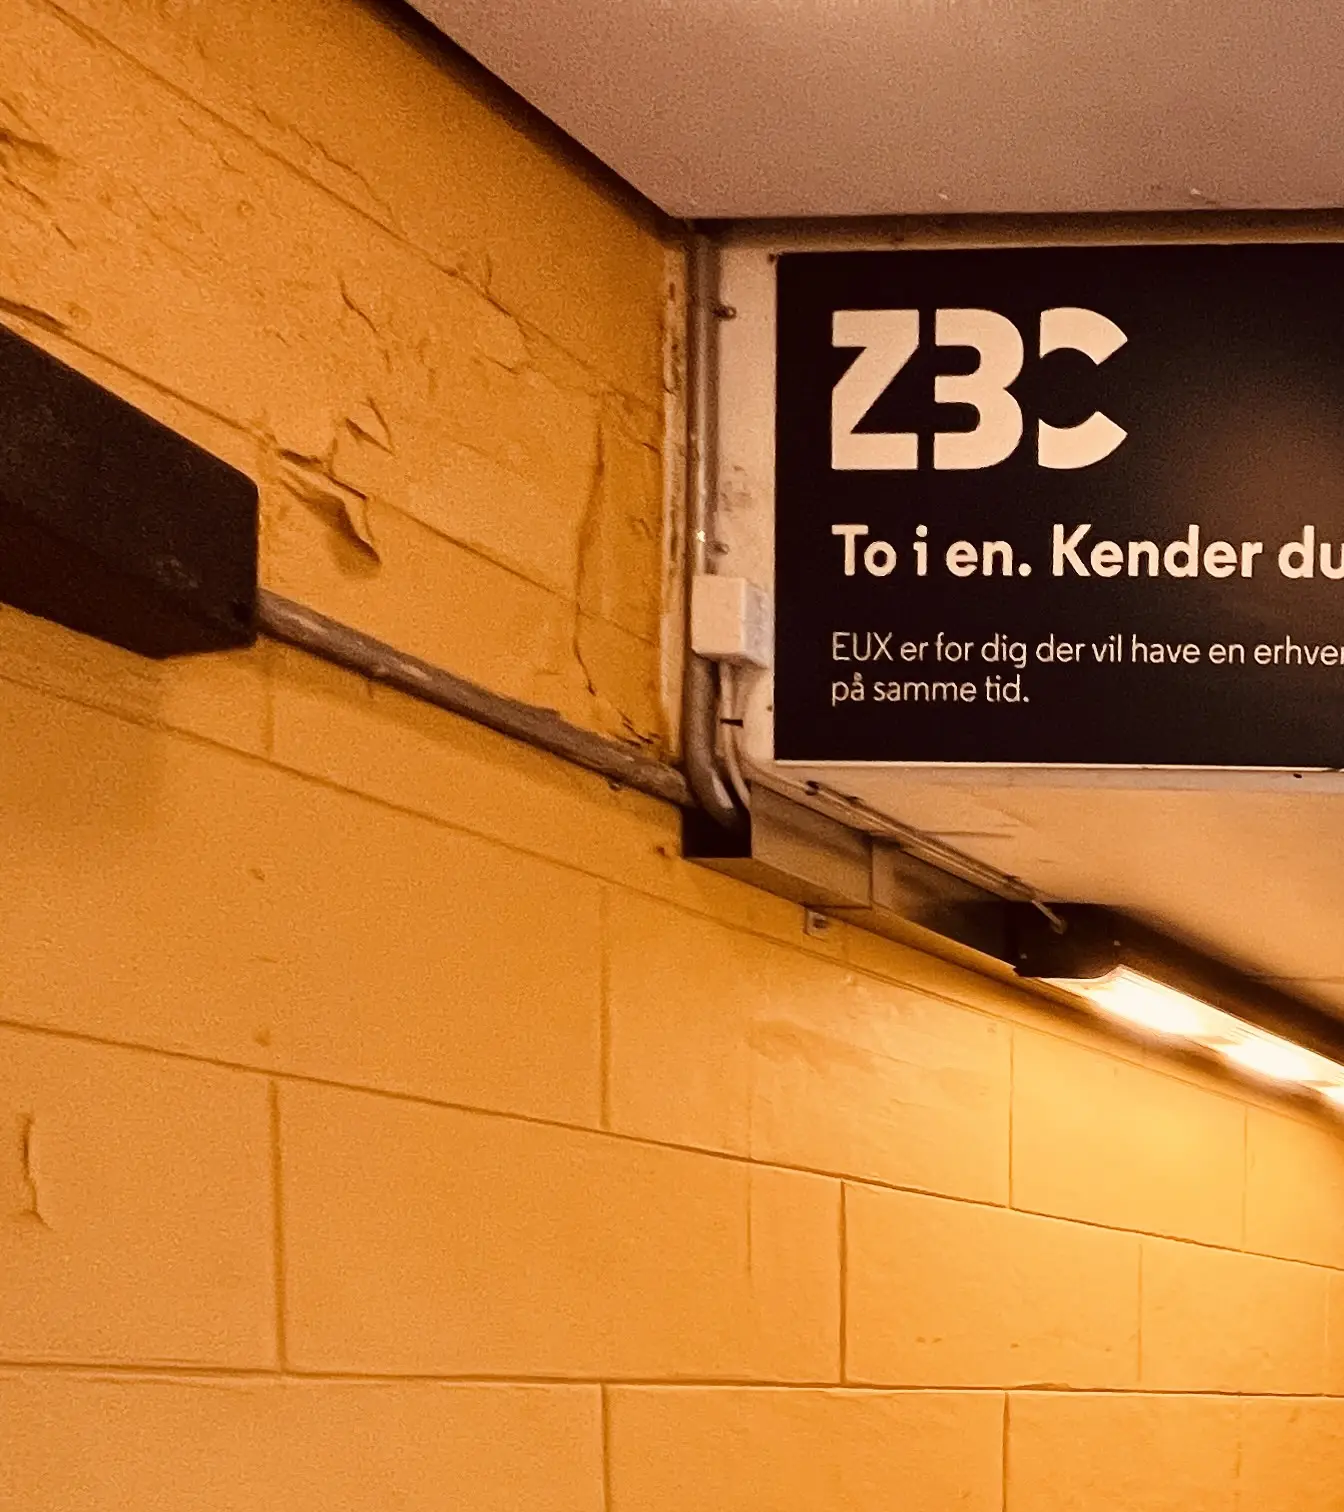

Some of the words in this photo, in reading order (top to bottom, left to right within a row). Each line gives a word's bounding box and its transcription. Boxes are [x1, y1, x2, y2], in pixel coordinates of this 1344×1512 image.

[831, 307, 1128, 471] ZBC
[831, 524, 897, 577] To
[913, 524, 928, 577] i
[945, 540, 1032, 577] en.
[1052, 523, 1263, 578] Kender
[832, 631, 893, 663] EUX
[899, 640, 931, 662] er
[936, 632, 974, 662] for
[981, 633, 1027, 670] dig
[1035, 633, 1085, 663] der
[1091, 633, 1122, 663] vil
[1131, 633, 1201, 664] have
[1208, 643, 1245, 664] en
[831, 672, 865, 706] på
[873, 681, 977, 703] samme
[985, 673, 1030, 703] tid.
